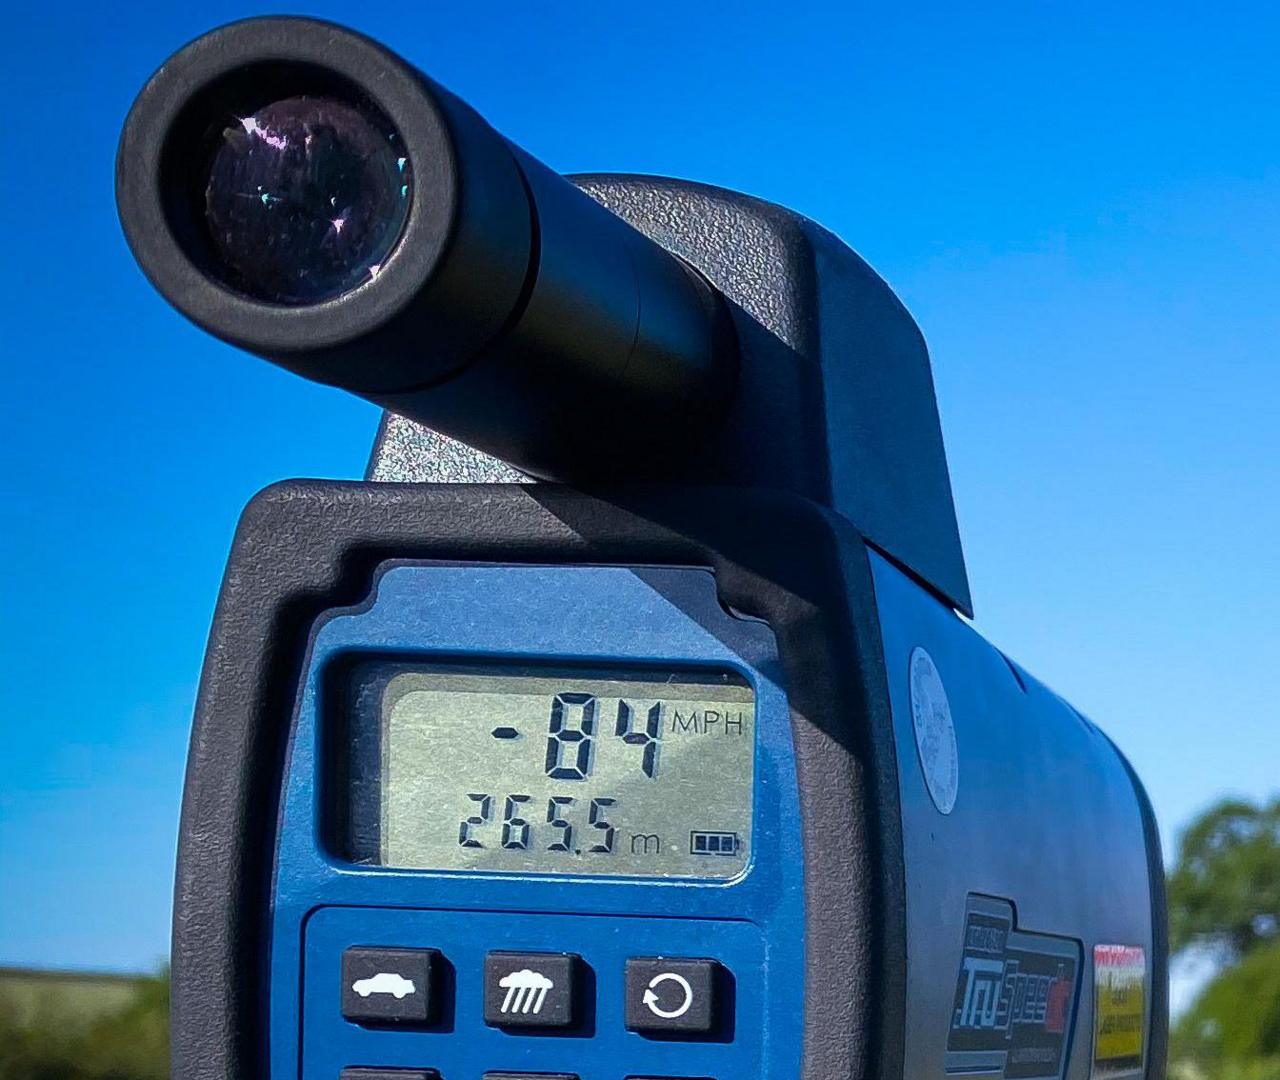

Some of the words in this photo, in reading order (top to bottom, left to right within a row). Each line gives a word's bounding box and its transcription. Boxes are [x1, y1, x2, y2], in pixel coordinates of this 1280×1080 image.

[491, 692, 662, 780] -84
[671, 709, 744, 735] MPH
[458, 793, 616, 856] 265.5
[631, 831, 661, 855] m
